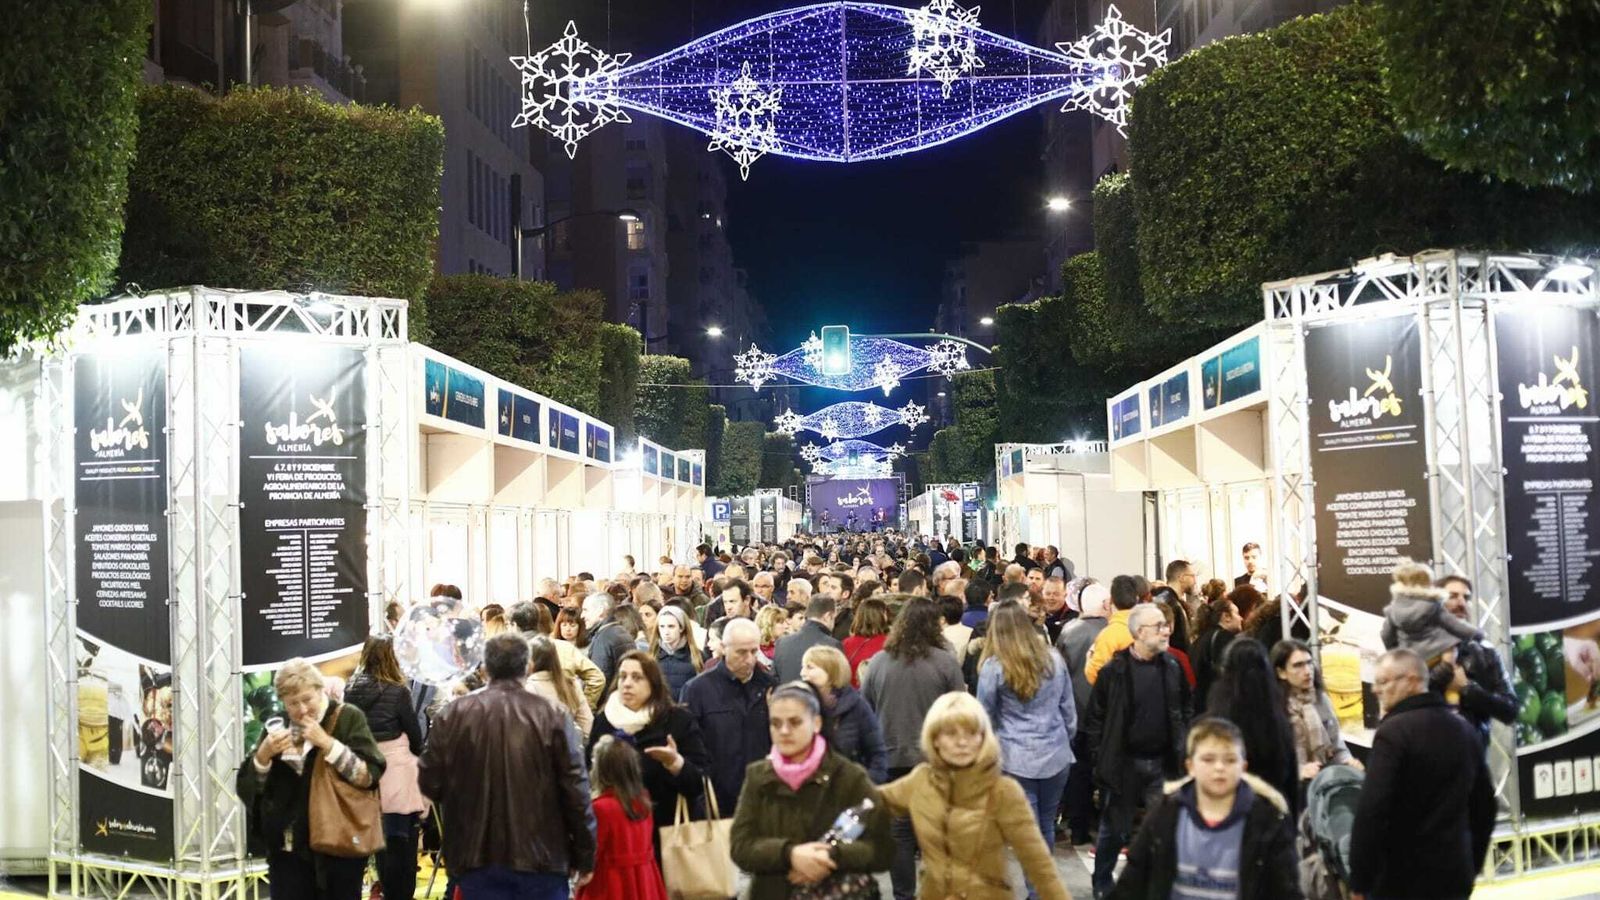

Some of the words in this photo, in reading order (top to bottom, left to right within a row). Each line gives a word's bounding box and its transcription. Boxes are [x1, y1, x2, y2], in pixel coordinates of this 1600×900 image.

[1328, 386, 1402, 422] sabores
[1340, 417, 1372, 428] ALMERÍA
[90, 416, 150, 452] sabores
[265, 412, 345, 446] sabores
[277, 443, 312, 452] ALMERÍA
[302, 464, 335, 472] DICIEMBRE
[263, 482, 326, 490] AGROALIMENTARIOS
[328, 482, 336, 490] DE
[337, 482, 345, 490] LA
[269, 492, 303, 500] PROVINCIA
[304, 492, 312, 500] DE
[314, 490, 341, 499] ALMERÍA
[837, 492, 874, 506] sabores
[1336, 493, 1362, 501] JAMONES
[1388, 490, 1405, 498] VINOS
[1326, 503, 1348, 511] ACEITES
[1350, 501, 1382, 509] CONSERVAS
[1384, 499, 1416, 507] VEGETALES
[716, 505, 726, 519] P
[1335, 512, 1358, 520] TOMATE
[1385, 509, 1408, 517] CARNES
[265, 519, 298, 527] EMPRESAS
[299, 517, 345, 527] PARTICIPANTES
[1338, 520, 1370, 528] SALAZONES
[1372, 518, 1406, 527] PANADERÍA
[92, 524, 114, 532] JAMONES
[114, 524, 133, 532] QUESOS
[134, 524, 148, 532] VINOS
[1336, 530, 1369, 538] EMBUTIDOS
[1370, 528, 1408, 536] CHOCOLATES
[1337, 539, 1370, 547] PRODUCTOS
[1372, 537, 1410, 546] ECOLÓGICOS
[121, 552, 148, 560] PANADERÍA
[1348, 548, 1384, 556] ENCURTIDOS
[1385, 547, 1398, 555] MIEL
[92, 562, 118, 570] EMBUTIDOS
[119, 562, 150, 570] CHOCOLATES
[1347, 567, 1377, 575] COCKTAILS
[120, 571, 150, 580] ECOLÓGICOS
[101, 581, 129, 589] ENCURTIDOS
[96, 590, 118, 598] CERVEZAS
[120, 591, 146, 599] ARTESANAS
[124, 600, 144, 608] LICORES
